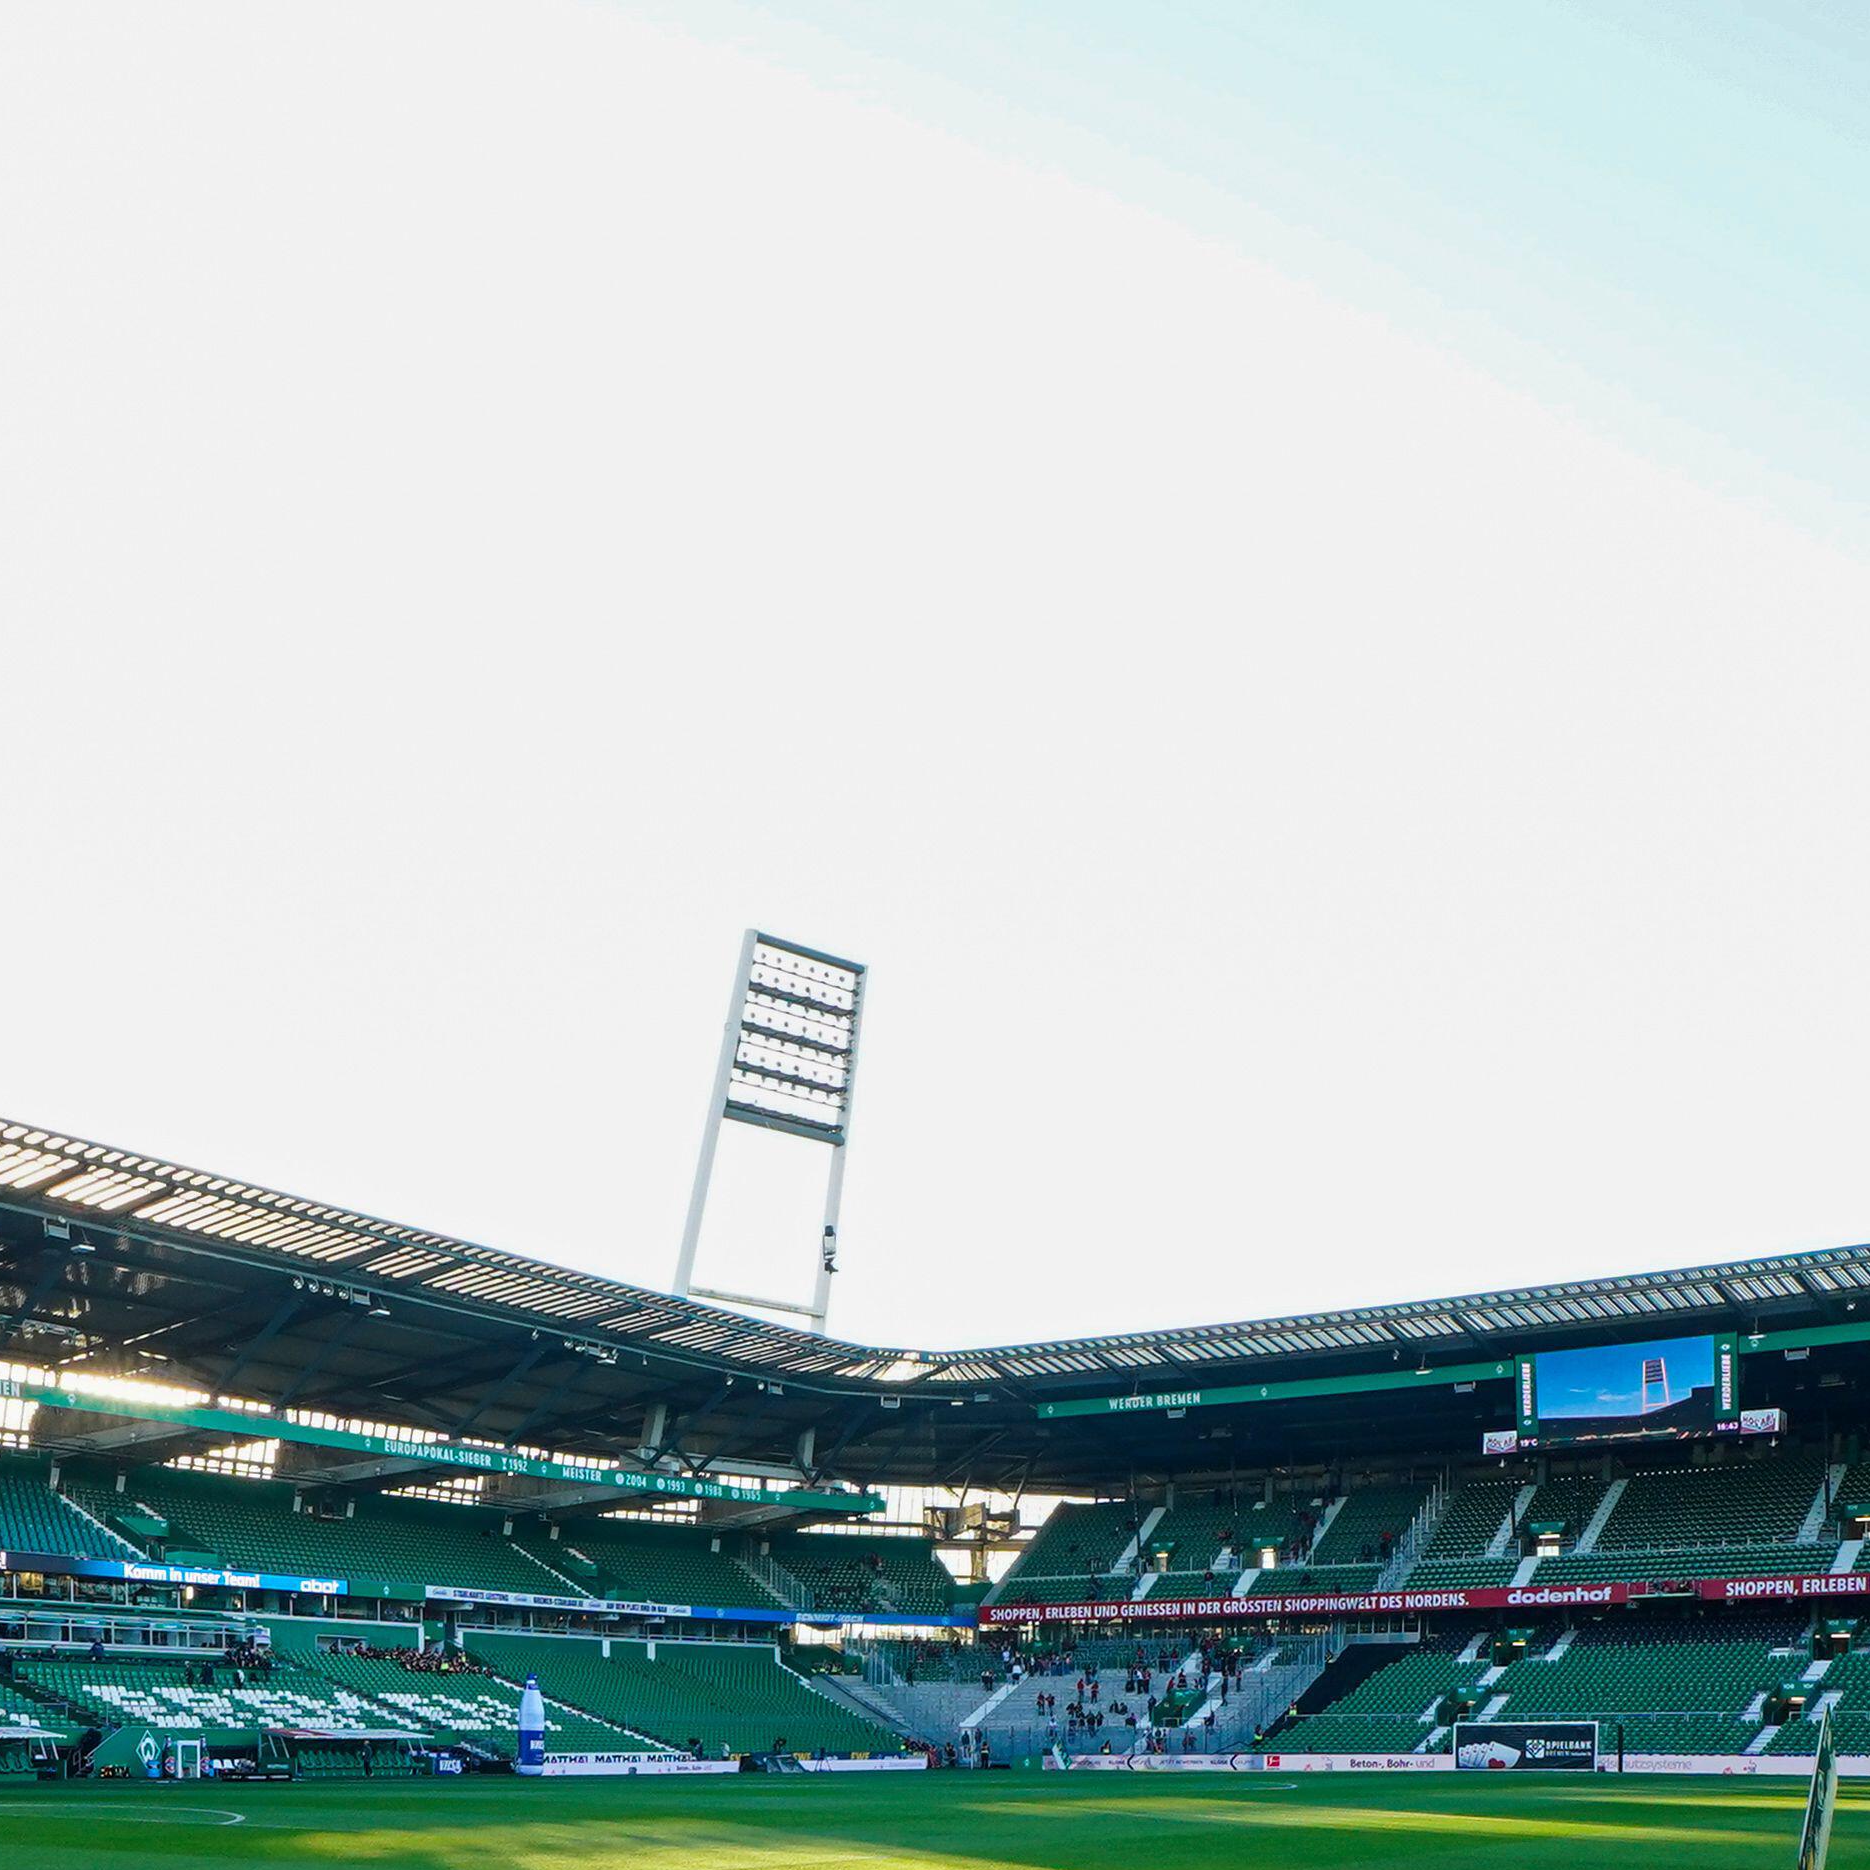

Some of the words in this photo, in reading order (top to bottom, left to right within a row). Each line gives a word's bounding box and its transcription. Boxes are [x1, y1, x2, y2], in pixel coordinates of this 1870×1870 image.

[1108, 1396, 1153, 1410] WERDER
[1156, 1392, 1201, 1408] BREMEN
[384, 1440, 492, 1468] EUROPAPOKAL-SIEGER
[508, 1458, 529, 1472] 1992
[561, 1465, 603, 1482] MEISTER
[625, 1473, 647, 1488] 2004
[665, 1478, 686, 1492] 1993
[124, 1562, 167, 1581] Komm
[169, 1567, 181, 1581] in
[184, 1570, 220, 1585] unser
[221, 1571, 261, 1588] Team!
[299, 1579, 339, 1594] abat
[1507, 1586, 1612, 1605] dodenhof
[1726, 1579, 1799, 1597] SHOPPEN,
[1802, 1576, 1867, 1594] ERLEBEN
[989, 1606, 1044, 1622] SHOPPEN,
[1045, 1603, 1092, 1619] ERLEBEN
[1094, 1603, 1119, 1618] UND
[1120, 1601, 1180, 1617] GENIESSEN
[1182, 1601, 1195, 1615] IN
[1197, 1600, 1222, 1615] DER
[1223, 1597, 1283, 1614] GRÖSSTEN
[1284, 1595, 1378, 1612] SHOPPINGWELT
[1379, 1595, 1403, 1610] DES
[1405, 1592, 1470, 1609] NORDENS.
[1349, 1757, 1385, 1769] Beton-,
[1386, 1758, 1415, 1769] Bohr-
[1415, 1758, 1435, 1768] und
